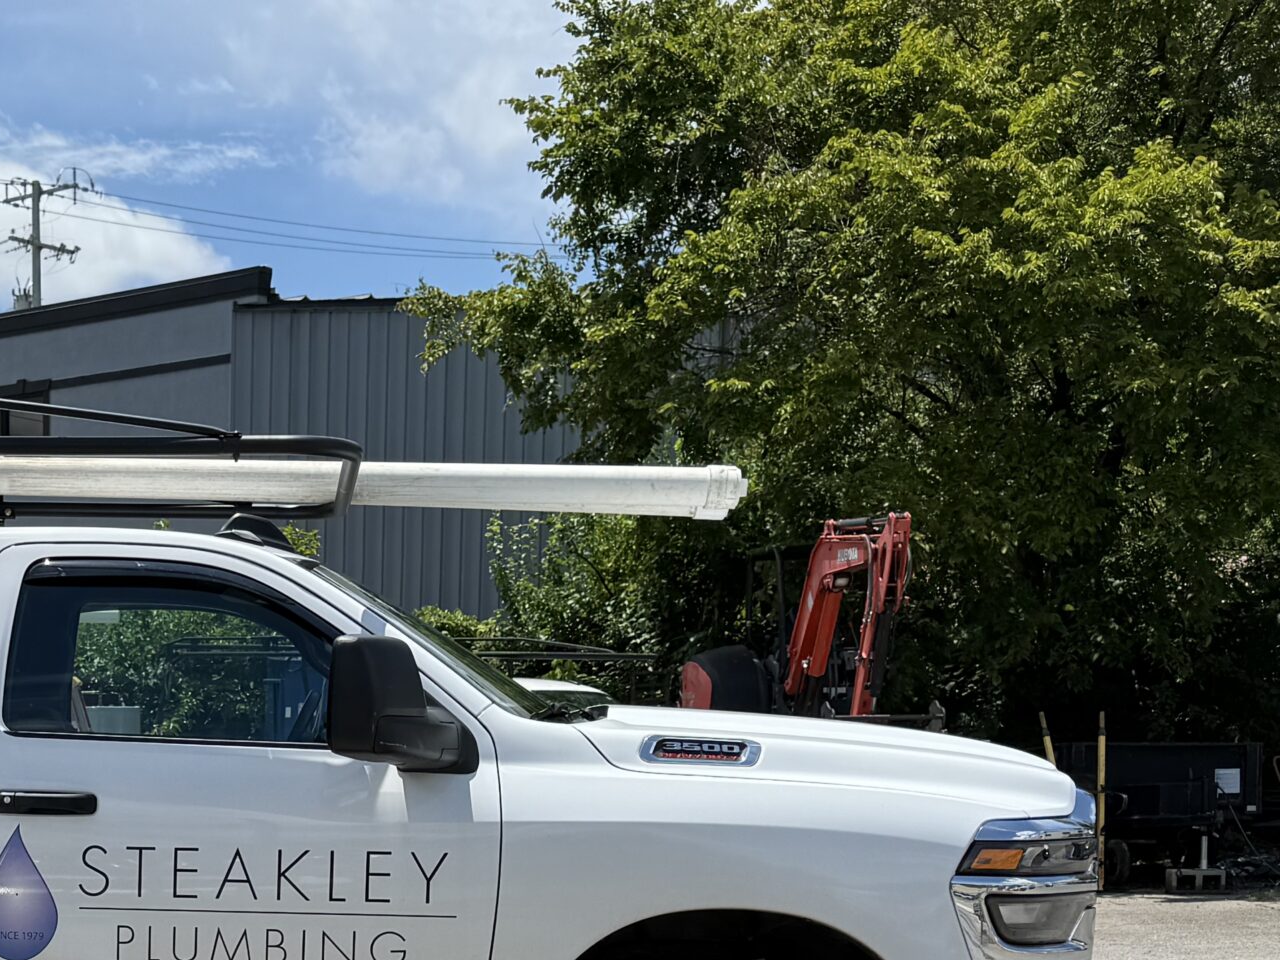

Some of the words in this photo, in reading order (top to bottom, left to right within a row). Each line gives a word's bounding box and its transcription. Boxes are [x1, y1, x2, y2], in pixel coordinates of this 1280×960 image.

[662, 741, 740, 753] 3500
[78, 845, 449, 904] STEAKLEY
[22, 931, 45, 940] 1979
